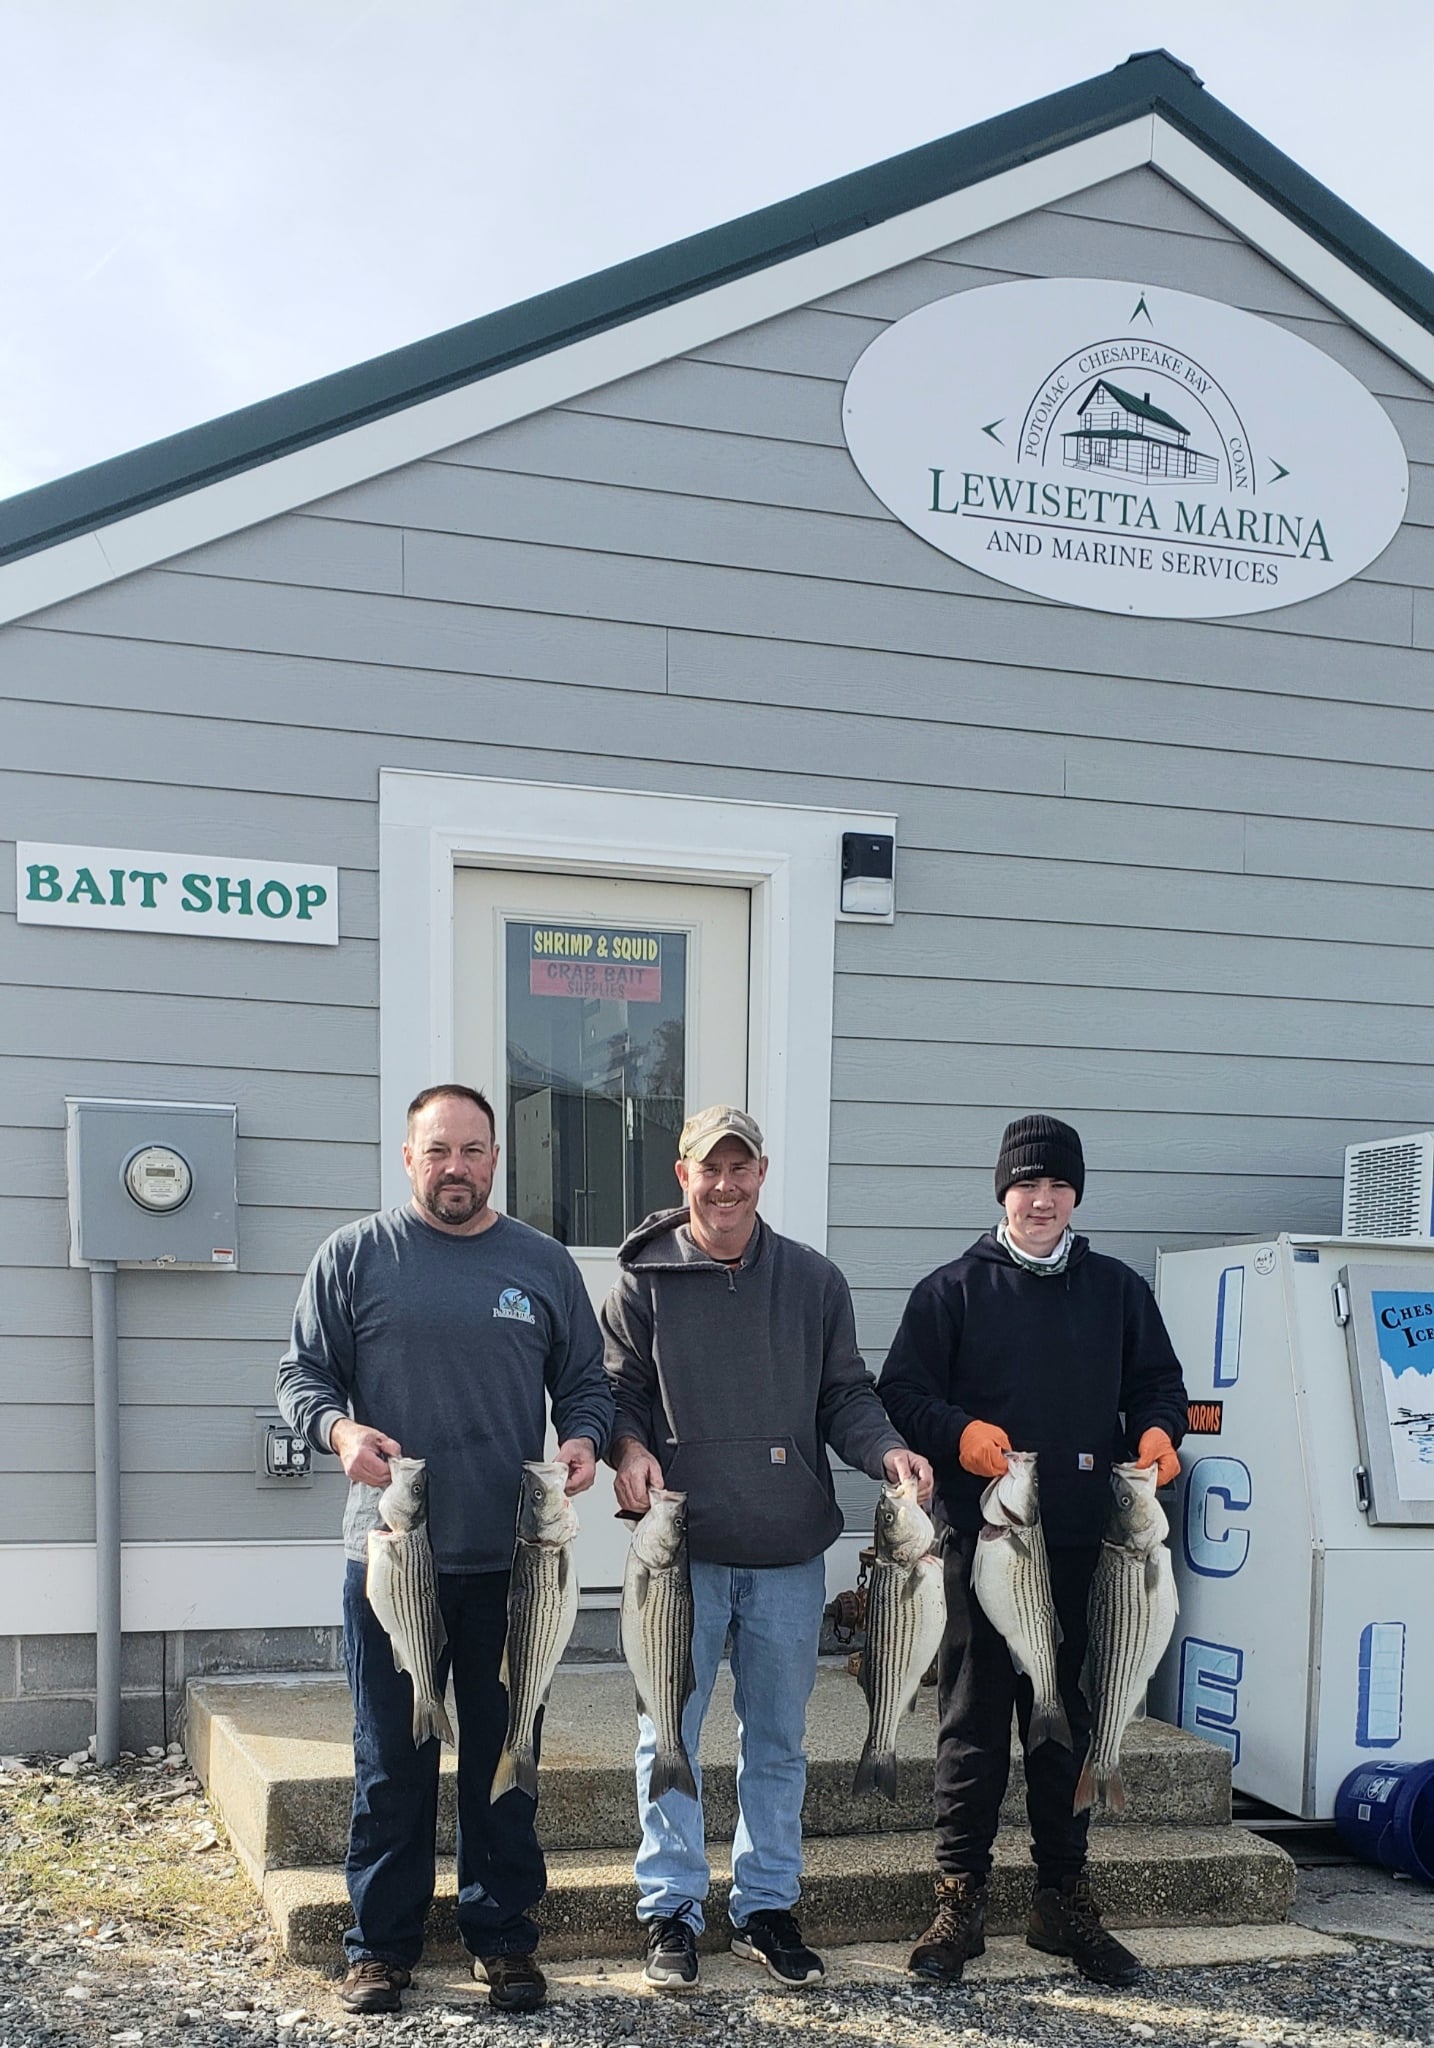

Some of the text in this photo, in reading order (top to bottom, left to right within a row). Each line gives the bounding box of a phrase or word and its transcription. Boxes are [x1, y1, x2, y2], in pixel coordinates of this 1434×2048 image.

[1078, 346, 1212, 395] CHESAPEAKE BAY
[1025, 375, 1070, 457] POTOMAC
[1229, 437, 1248, 489] COAN
[928, 468, 1334, 562] LEWISETTA MARINA
[986, 530, 1279, 585] AND MARINE SERVICES
[26, 864, 328, 920] BAIT SHOP
[533, 930, 658, 961] SHRIMP & SQUID
[547, 962, 646, 984] CRAB BAIT
[567, 980, 625, 998] SUPPLIES
